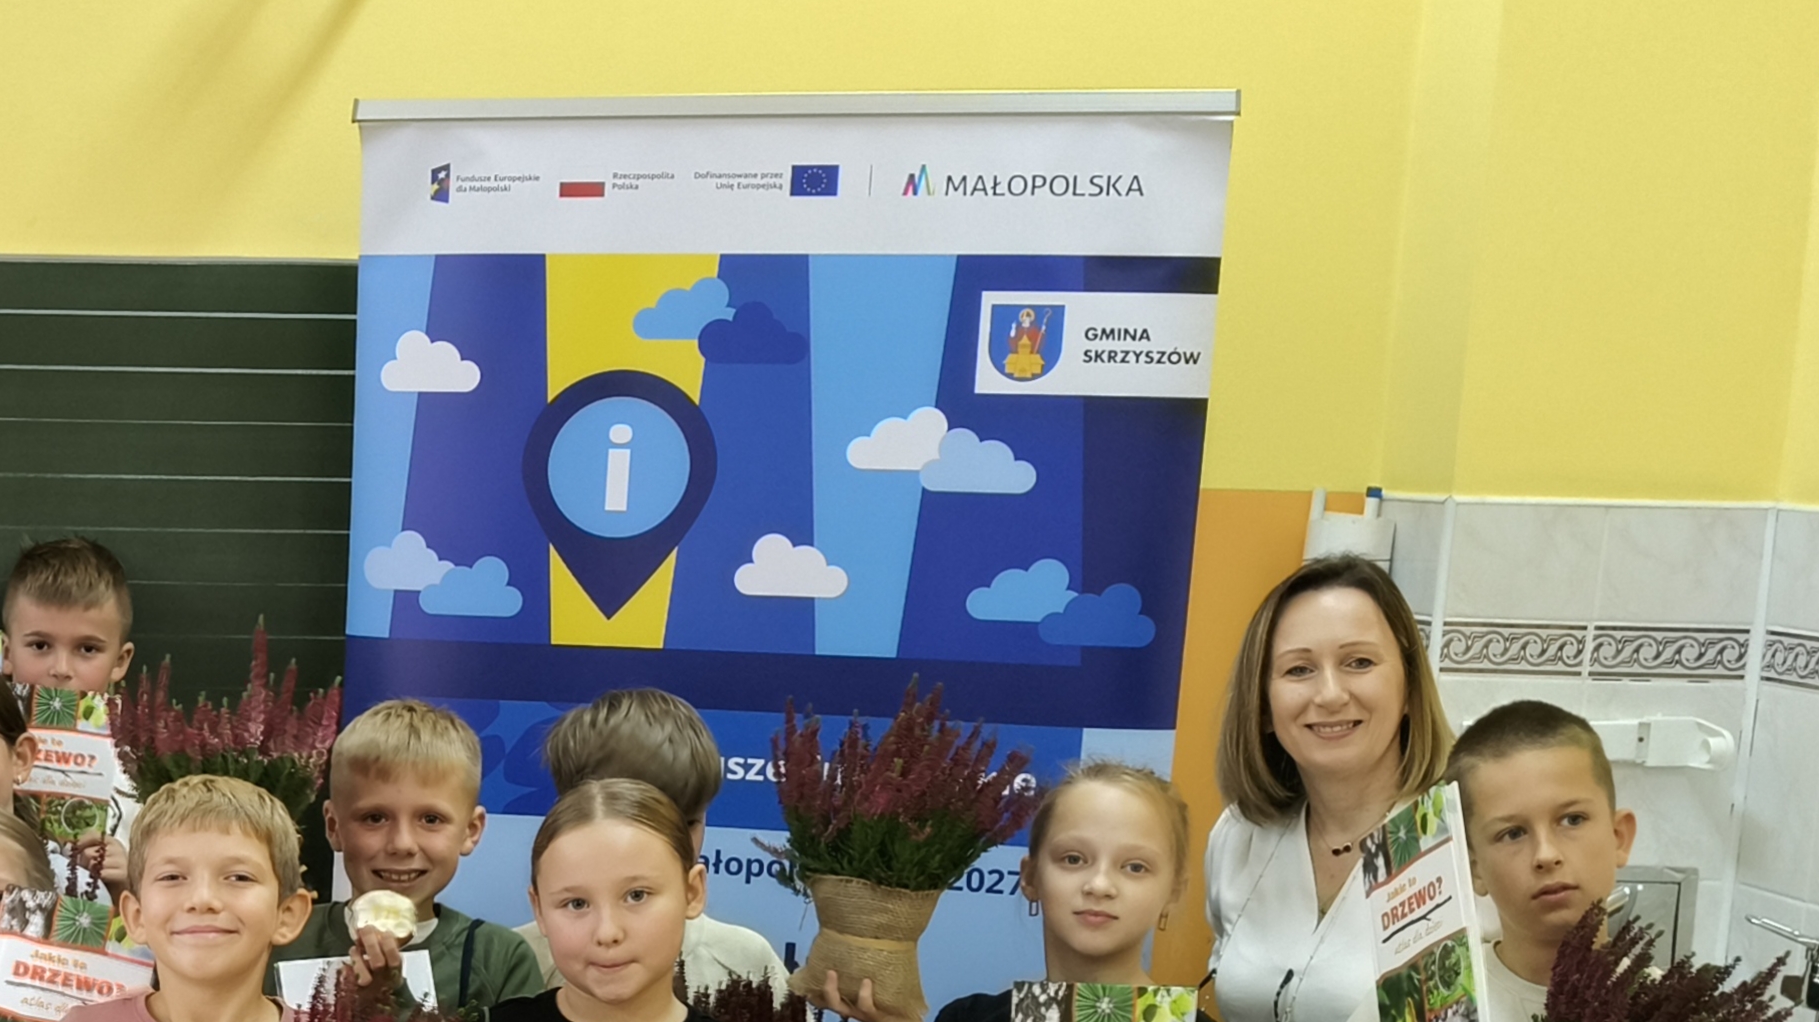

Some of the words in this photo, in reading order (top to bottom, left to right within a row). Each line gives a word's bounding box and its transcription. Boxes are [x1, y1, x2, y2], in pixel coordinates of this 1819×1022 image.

[456, 174, 492, 183] Fundusze
[494, 173, 541, 184] Europejskie
[612, 171, 675, 182] Rzeczpospolita
[693, 171, 758, 180] Dofinansowane
[760, 172, 784, 182] przez
[455, 184, 468, 193] dla
[612, 182, 639, 191] Polska
[715, 181, 735, 192] Unię
[737, 181, 783, 192] Europejską
[944, 174, 1145, 197] MAŁOPOLSKA
[1084, 327, 1151, 342] GMINA
[1082, 347, 1201, 365] SKRZYSZÓW
[36, 749, 97, 768] ZEWO?
[1380, 875, 1443, 932] DRZEWO?
[30, 949, 69, 966] Jakie
